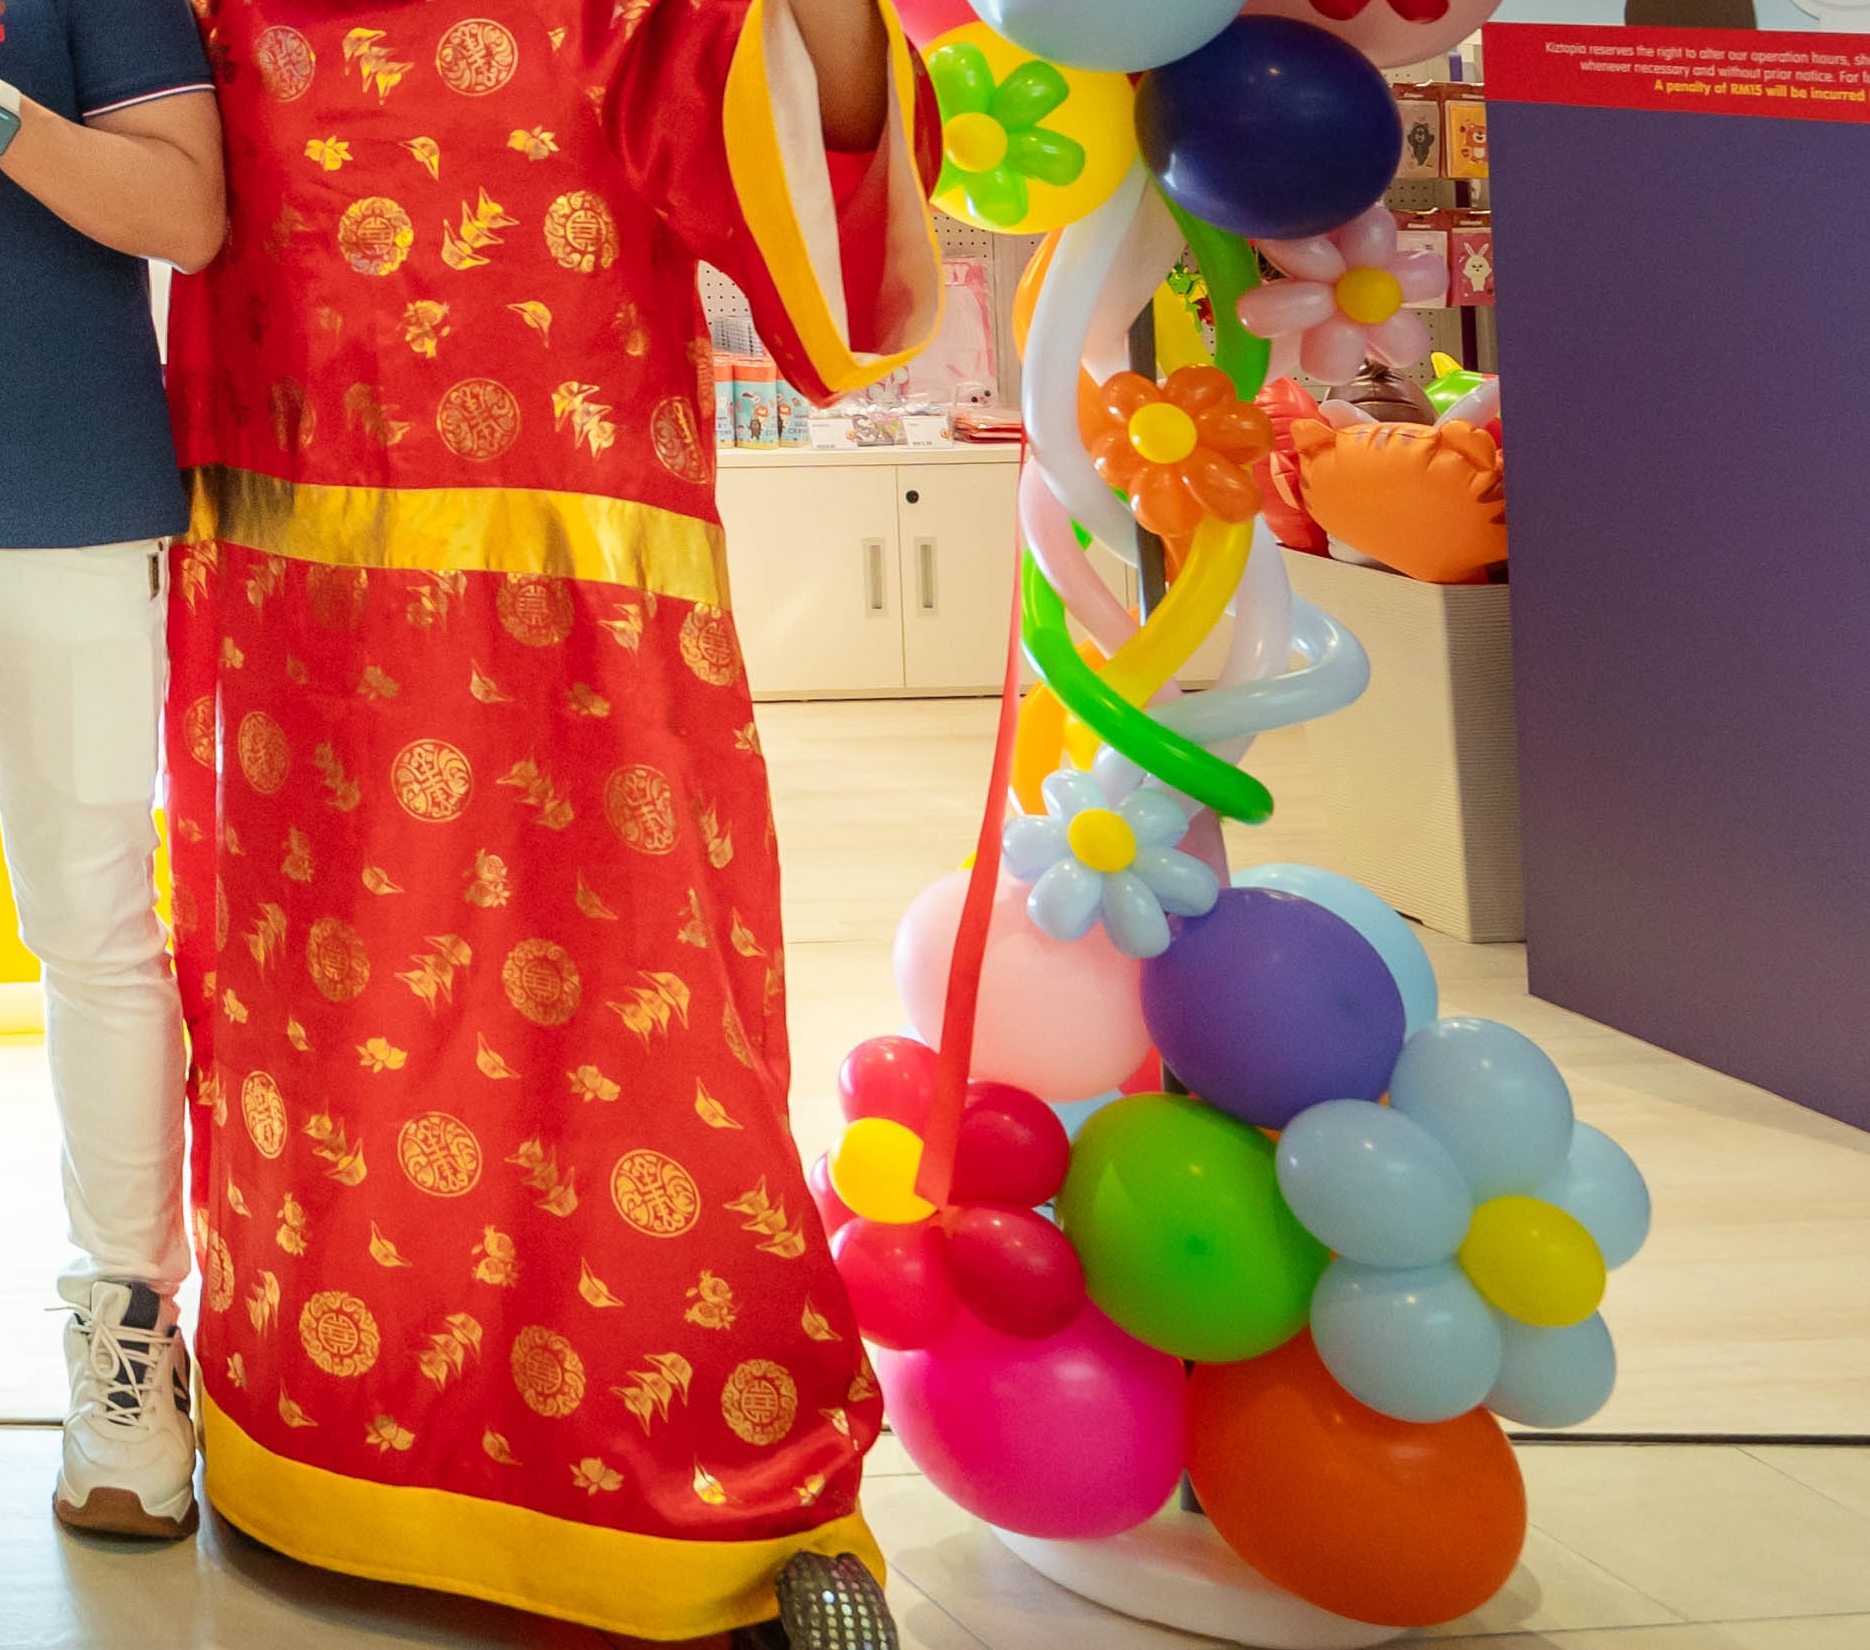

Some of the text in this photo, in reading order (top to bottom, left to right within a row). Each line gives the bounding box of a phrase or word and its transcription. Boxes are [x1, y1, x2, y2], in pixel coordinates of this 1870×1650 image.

[1545, 42, 1586, 56] Kiztopia
[1589, 45, 1634, 56] reserves
[1636, 45, 1654, 57] the
[1657, 47, 1682, 60] right
[1685, 48, 1696, 58] to
[1699, 48, 1725, 60] alter
[1727, 51, 1748, 60] our
[1750, 51, 1809, 64] operation
[1811, 52, 1850, 66] hours,
[1580, 60, 1631, 72] whenever
[1634, 64, 1690, 78] necessary
[1693, 65, 1715, 77] and
[1717, 65, 1760, 79] without
[1764, 69, 1792, 82] prior
[1654, 79, 1865, 101] A penalty of RM15 will be incurred
